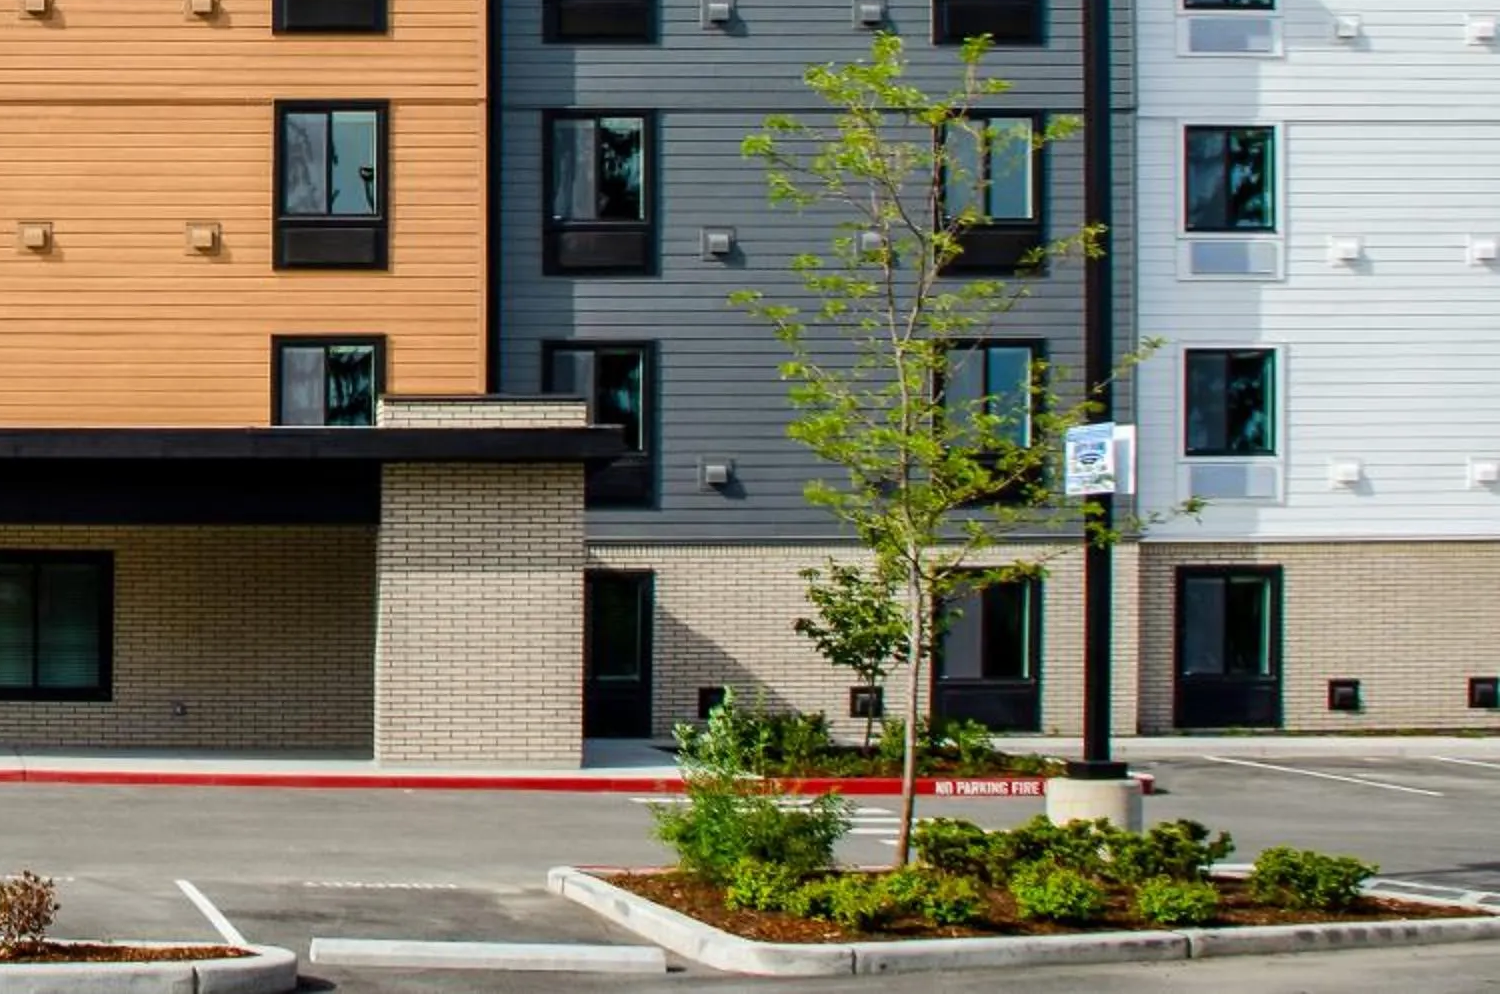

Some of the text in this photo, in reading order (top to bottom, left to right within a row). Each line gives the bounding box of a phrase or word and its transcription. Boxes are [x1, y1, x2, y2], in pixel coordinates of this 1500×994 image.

[935, 781, 953, 795] NO
[956, 781, 1009, 795] PARKING
[1012, 781, 1040, 795] FIRE
